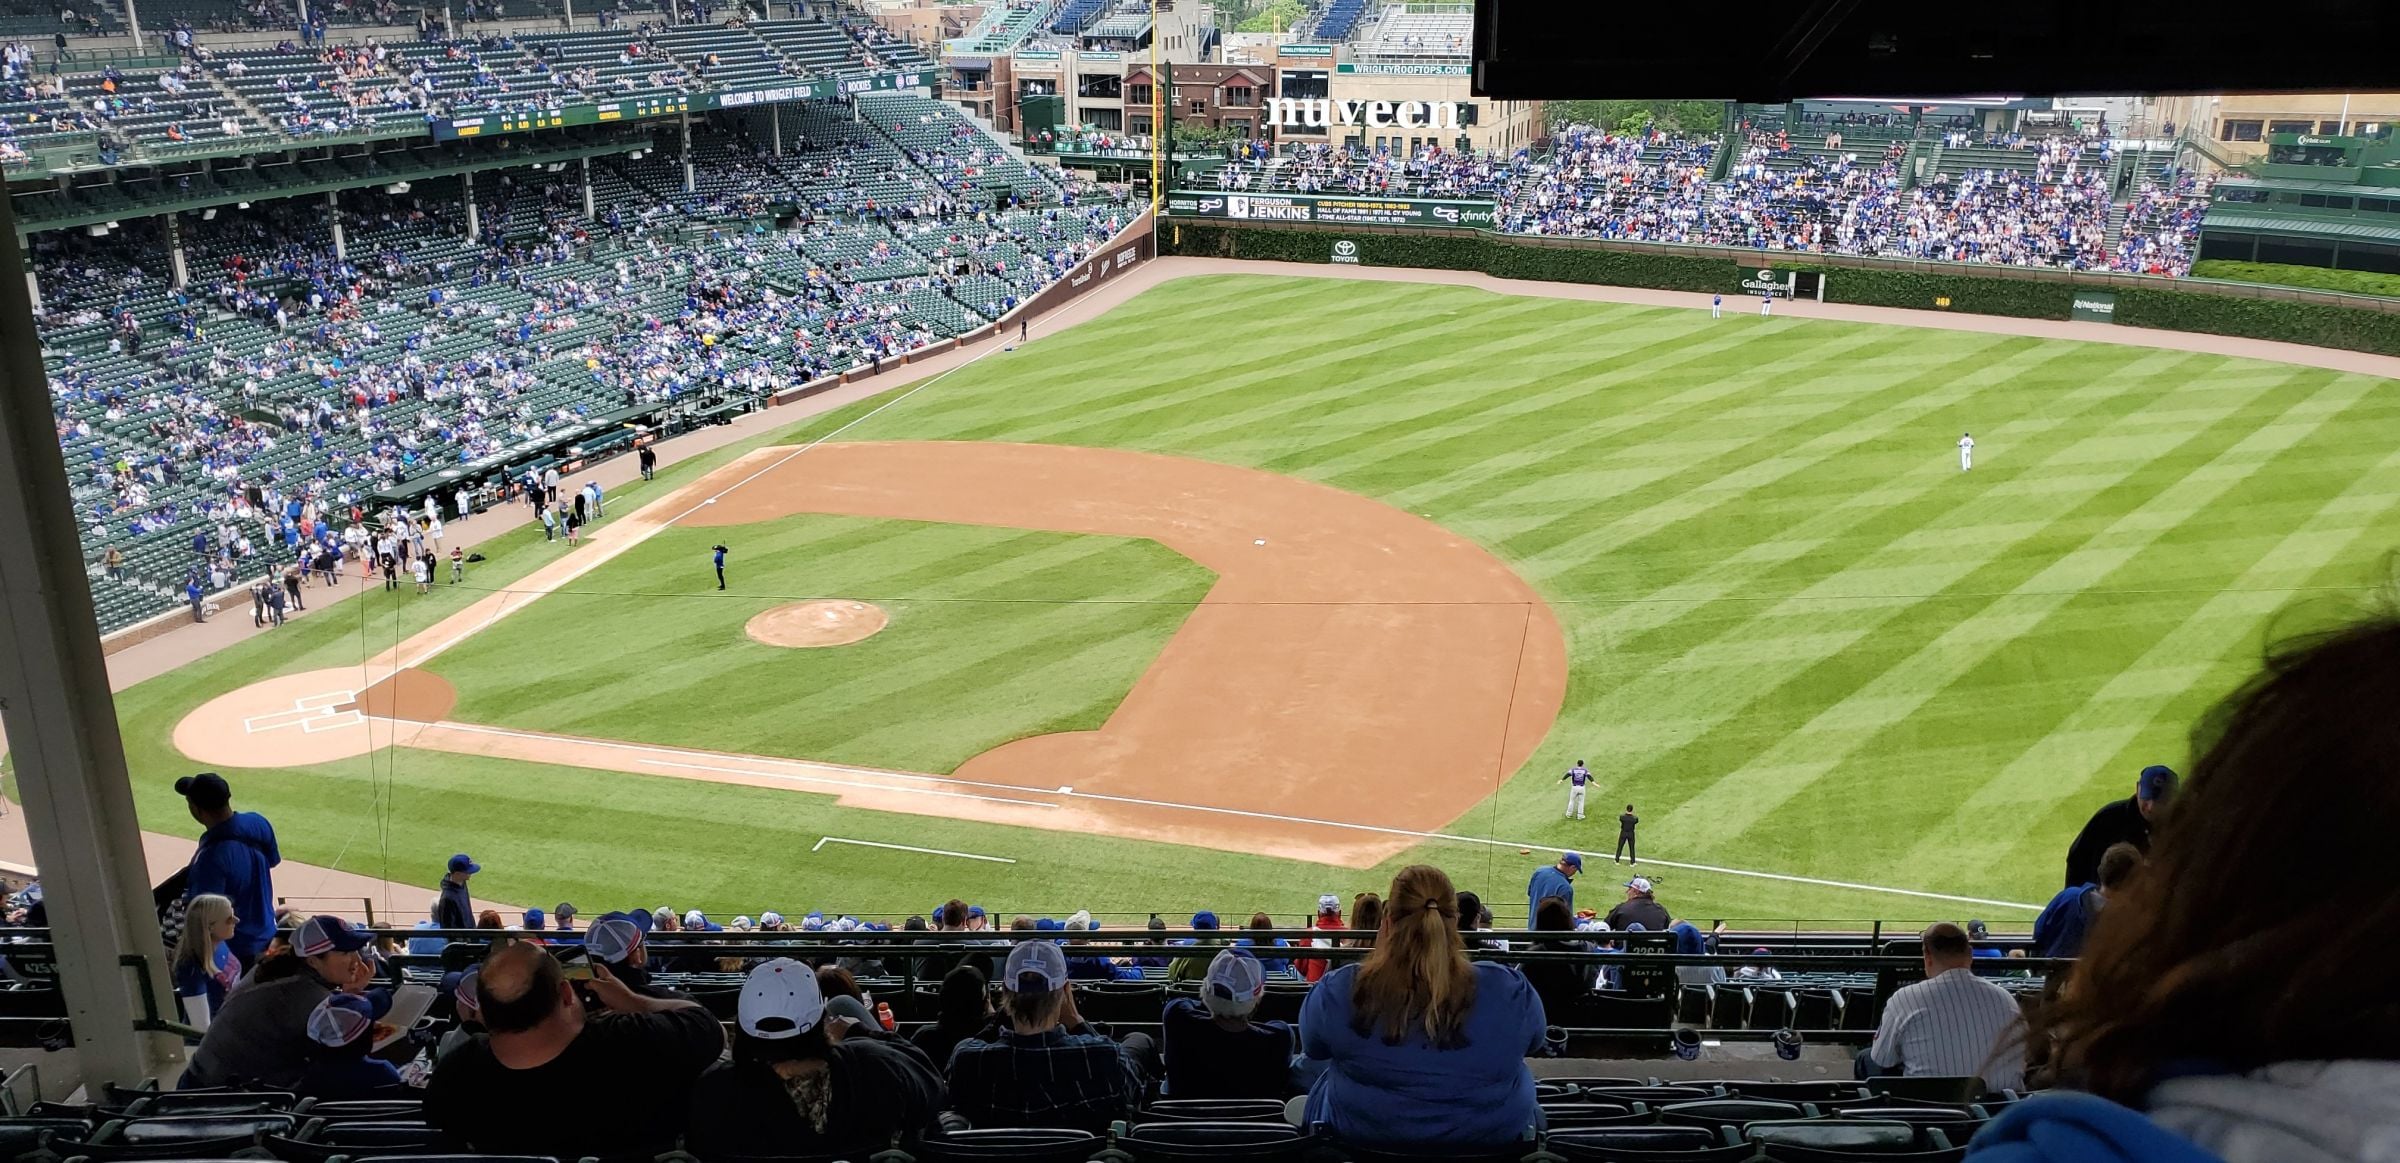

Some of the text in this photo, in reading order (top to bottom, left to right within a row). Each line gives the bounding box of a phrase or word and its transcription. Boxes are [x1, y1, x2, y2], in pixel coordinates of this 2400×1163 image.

[848, 80, 871, 92] ROCKIES
[906, 75, 919, 86] CUBS
[720, 85, 812, 106] WELCOME TO WRIGLEY FIELD
[1267, 97, 1461, 129] nuveen
[1250, 198, 1292, 206] FERGUSON
[1250, 207, 1310, 219] JENKINS
[1460, 210, 1493, 223] xfinity
[1331, 255, 1359, 263] TOYOTA
[1741, 279, 1789, 291] Gallagher
[1747, 289, 1783, 297] INSURNCE
[2082, 301, 2114, 310] National
